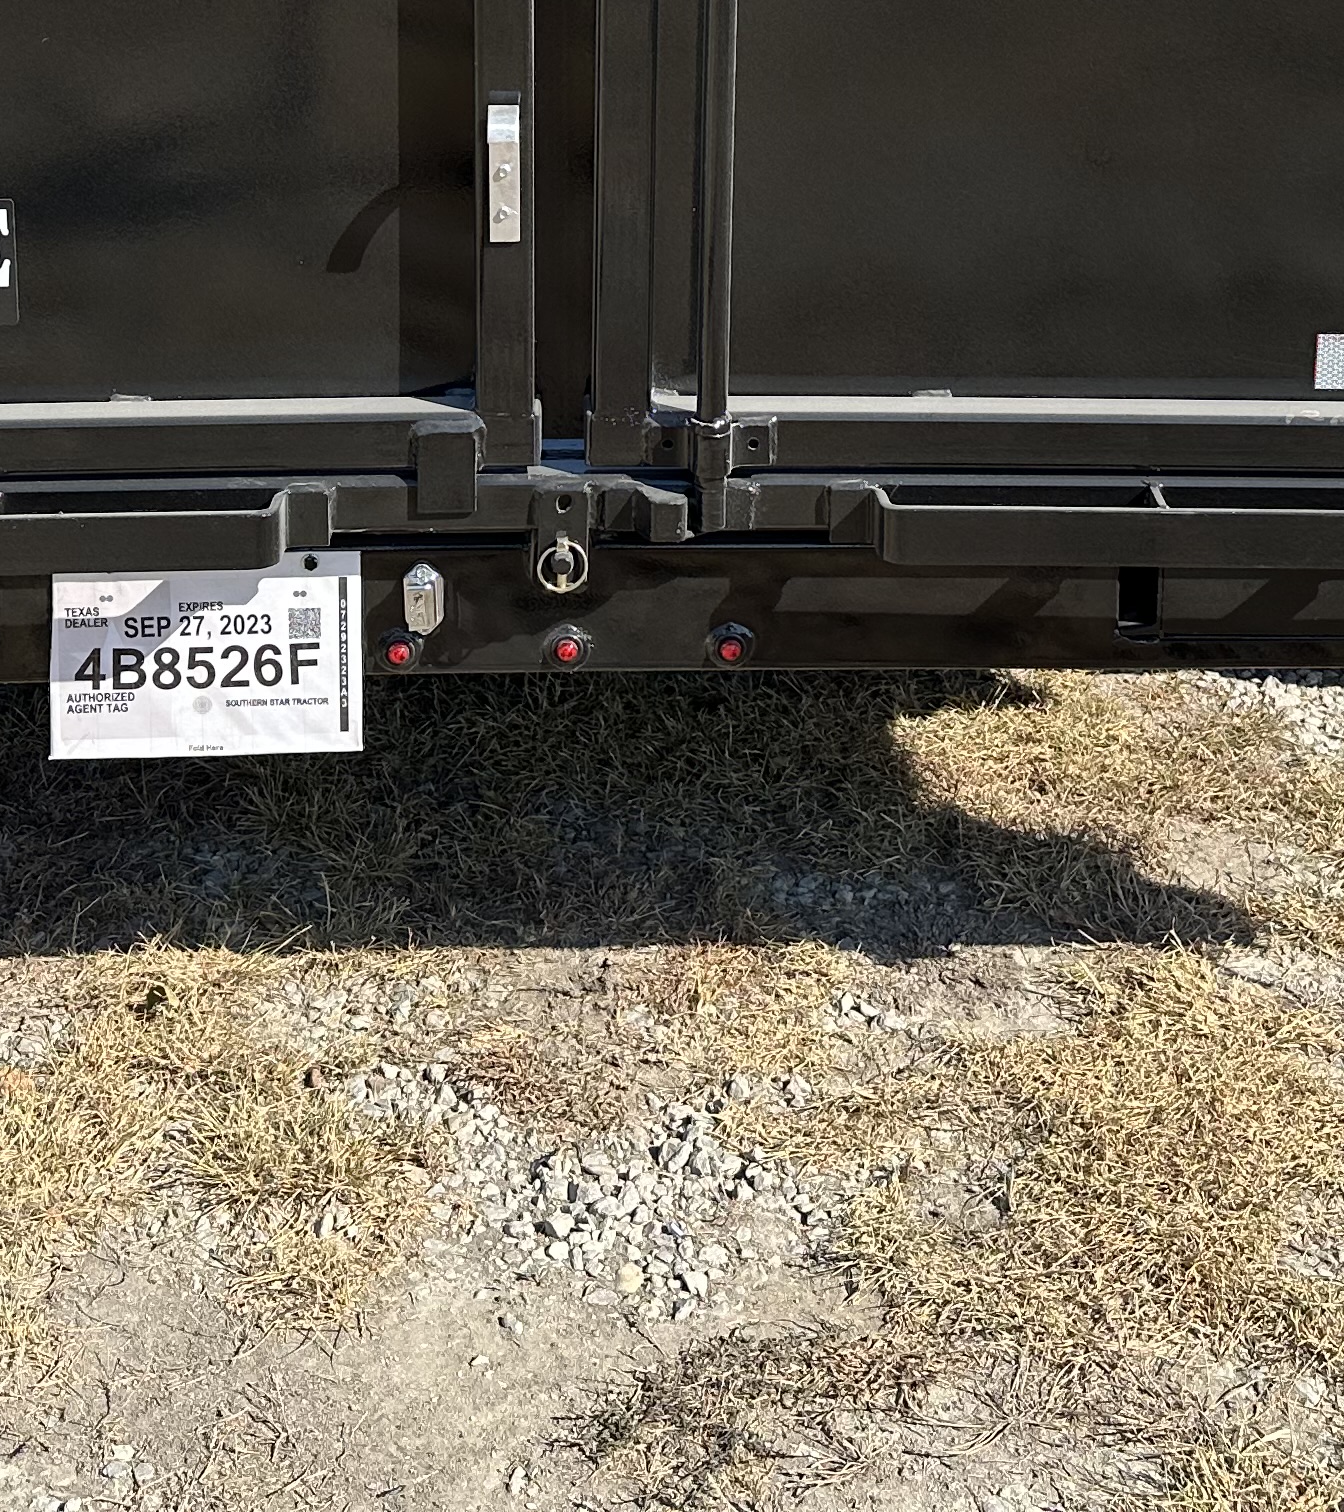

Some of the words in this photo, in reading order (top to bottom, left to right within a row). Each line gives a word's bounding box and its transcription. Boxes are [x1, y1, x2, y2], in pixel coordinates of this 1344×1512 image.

[64, 607, 100, 618] TEXAS
[178, 601, 224, 612] EXPIRES
[64, 617, 109, 629] DEALER
[123, 616, 172, 638] SEP
[179, 615, 212, 640] 27,
[219, 613, 273, 636] 2023
[74, 642, 321, 691] 4B8526F
[66, 691, 135, 704] AUTHORIZED
[225, 698, 268, 707] SOUTHERN
[269, 698, 290, 707] STAR
[291, 697, 330, 706] TRACTOR
[66, 703, 105, 715] AGENT
[106, 702, 129, 713] TAG
